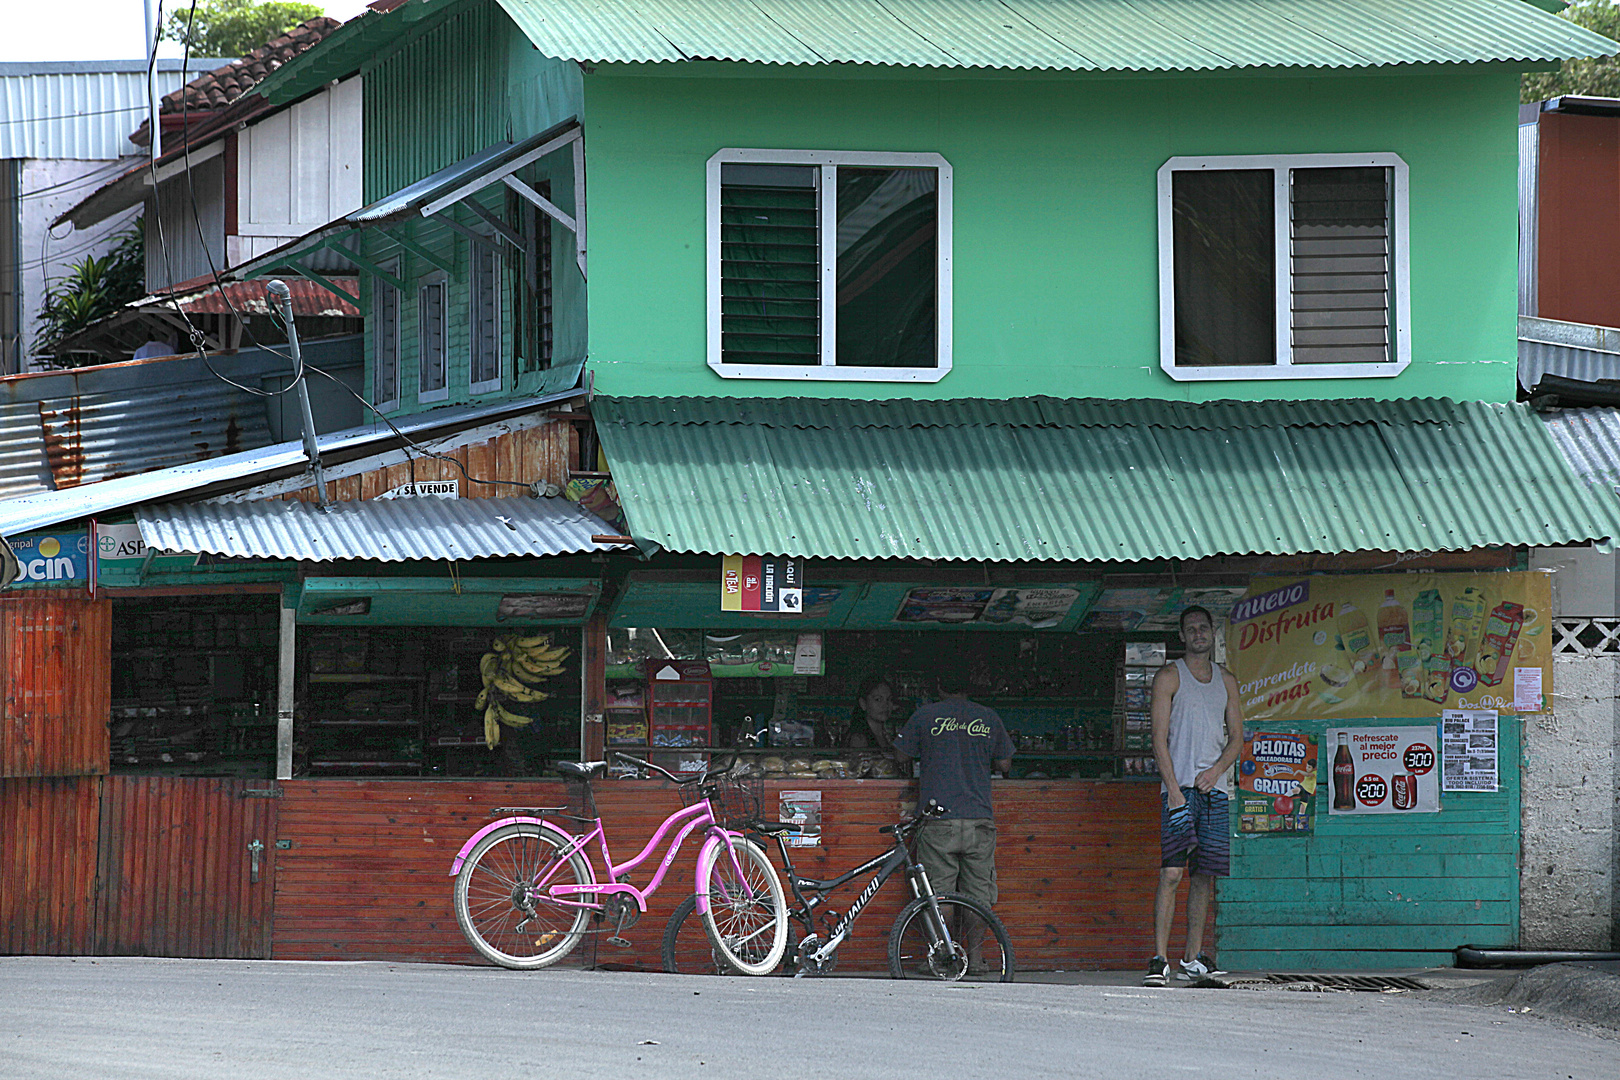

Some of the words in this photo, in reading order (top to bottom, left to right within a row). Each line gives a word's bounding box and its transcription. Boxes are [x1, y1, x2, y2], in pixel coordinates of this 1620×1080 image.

[404, 485, 417, 496] SE
[420, 484, 455, 494] VENDE
[10, 538, 33, 550] gripal
[727, 569, 737, 577] LA
[765, 563, 774, 574] LA
[725, 576, 739, 594] TEJA
[1236, 585, 1303, 619] nuevo
[1239, 602, 1335, 650] Disfruta
[1238, 661, 1317, 694] orprendete
[1246, 695, 1265, 706] con
[1267, 676, 1312, 707] más
[1458, 698, 1480, 709] Dos
[1494, 697, 1515, 708] Pin
[931, 717, 959, 736] Flor
[967, 718, 991, 737] Caña
[1353, 734, 1399, 742] Refrescate
[1252, 740, 1306, 758] PELOTAS
[1369, 743, 1396, 751] mejor
[1362, 750, 1398, 762] precio
[1408, 752, 1432, 767] 300
[1253, 778, 1301, 796] GRATIS
[1360, 784, 1385, 798] 200
